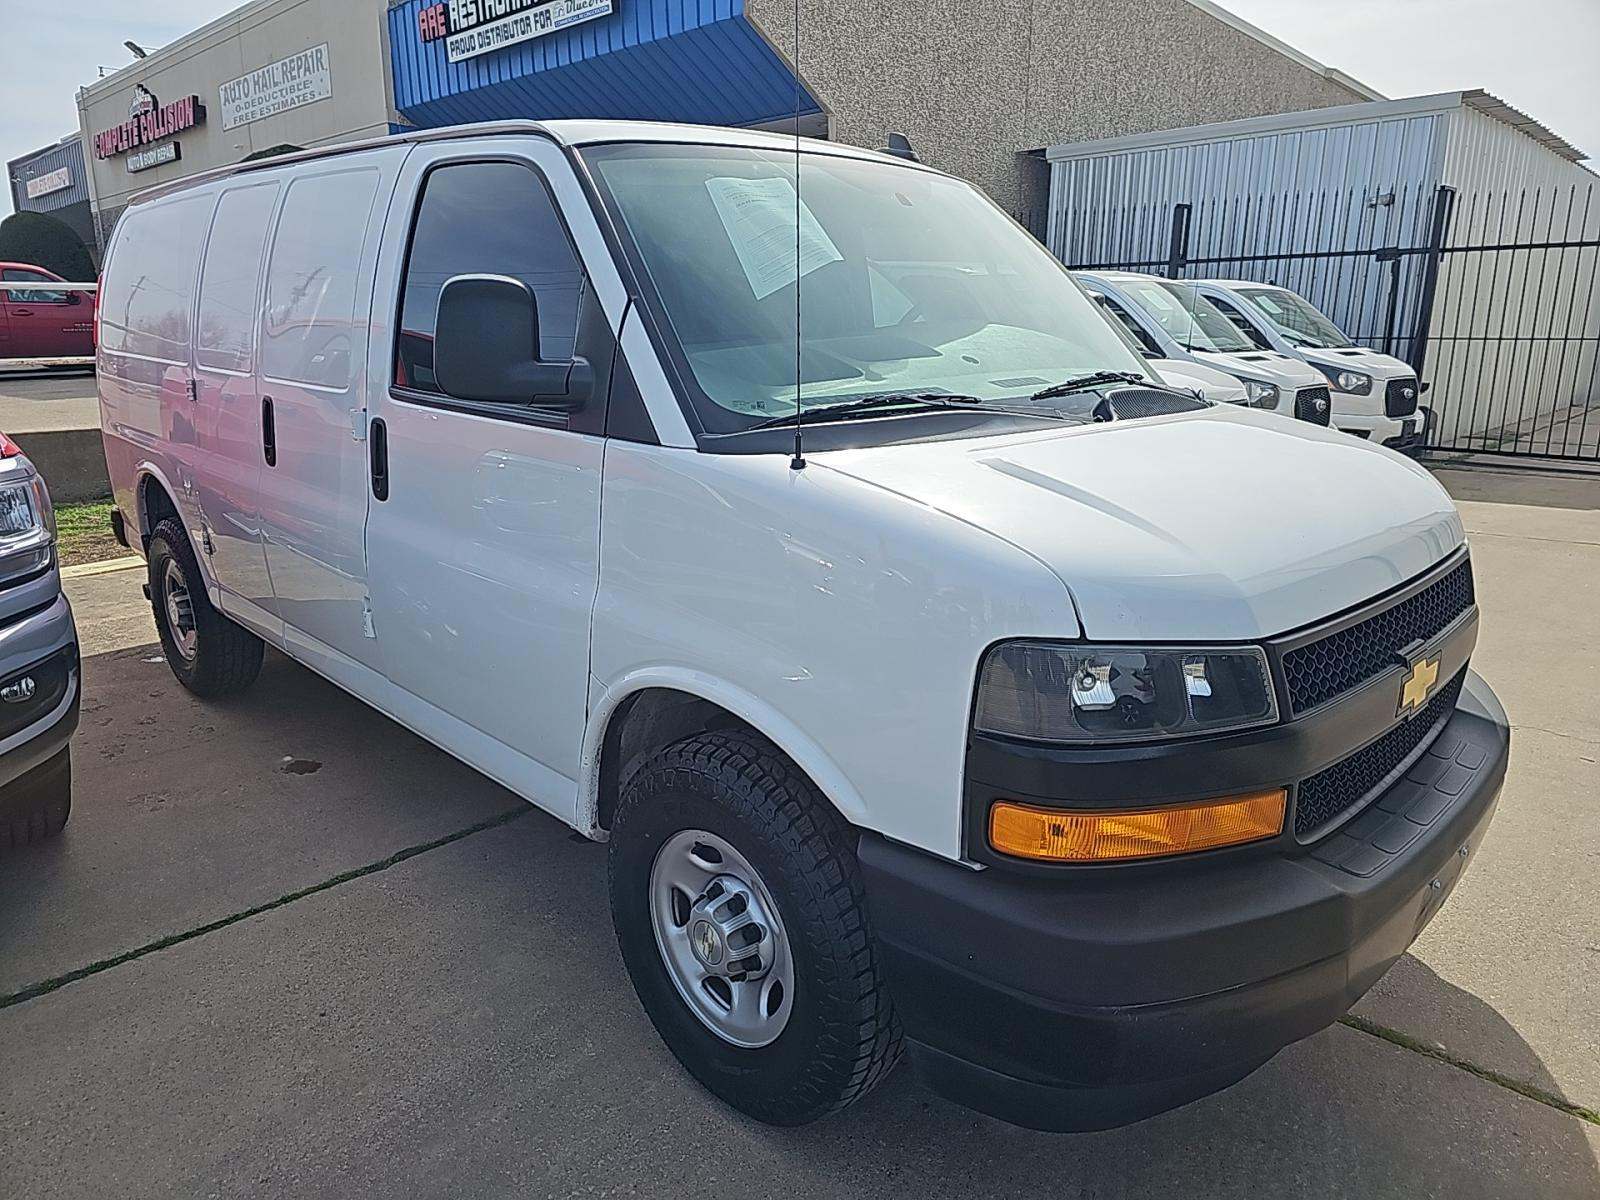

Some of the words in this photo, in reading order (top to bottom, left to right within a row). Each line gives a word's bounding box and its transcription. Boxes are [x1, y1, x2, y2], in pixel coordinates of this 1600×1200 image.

[450, 34, 476, 57] PROUD
[477, 15, 532, 49] DISTRIBUTOR
[533, 9, 553, 31] FOR
[223, 77, 250, 106] AUTO
[253, 66, 280, 95] HAIL
[281, 47, 325, 85] REPAIR
[94, 117, 139, 158] COMPLETE
[140, 96, 194, 144] COLLISION
[233, 110, 257, 125] FREE
[259, 90, 316, 117] ESTIMATES
